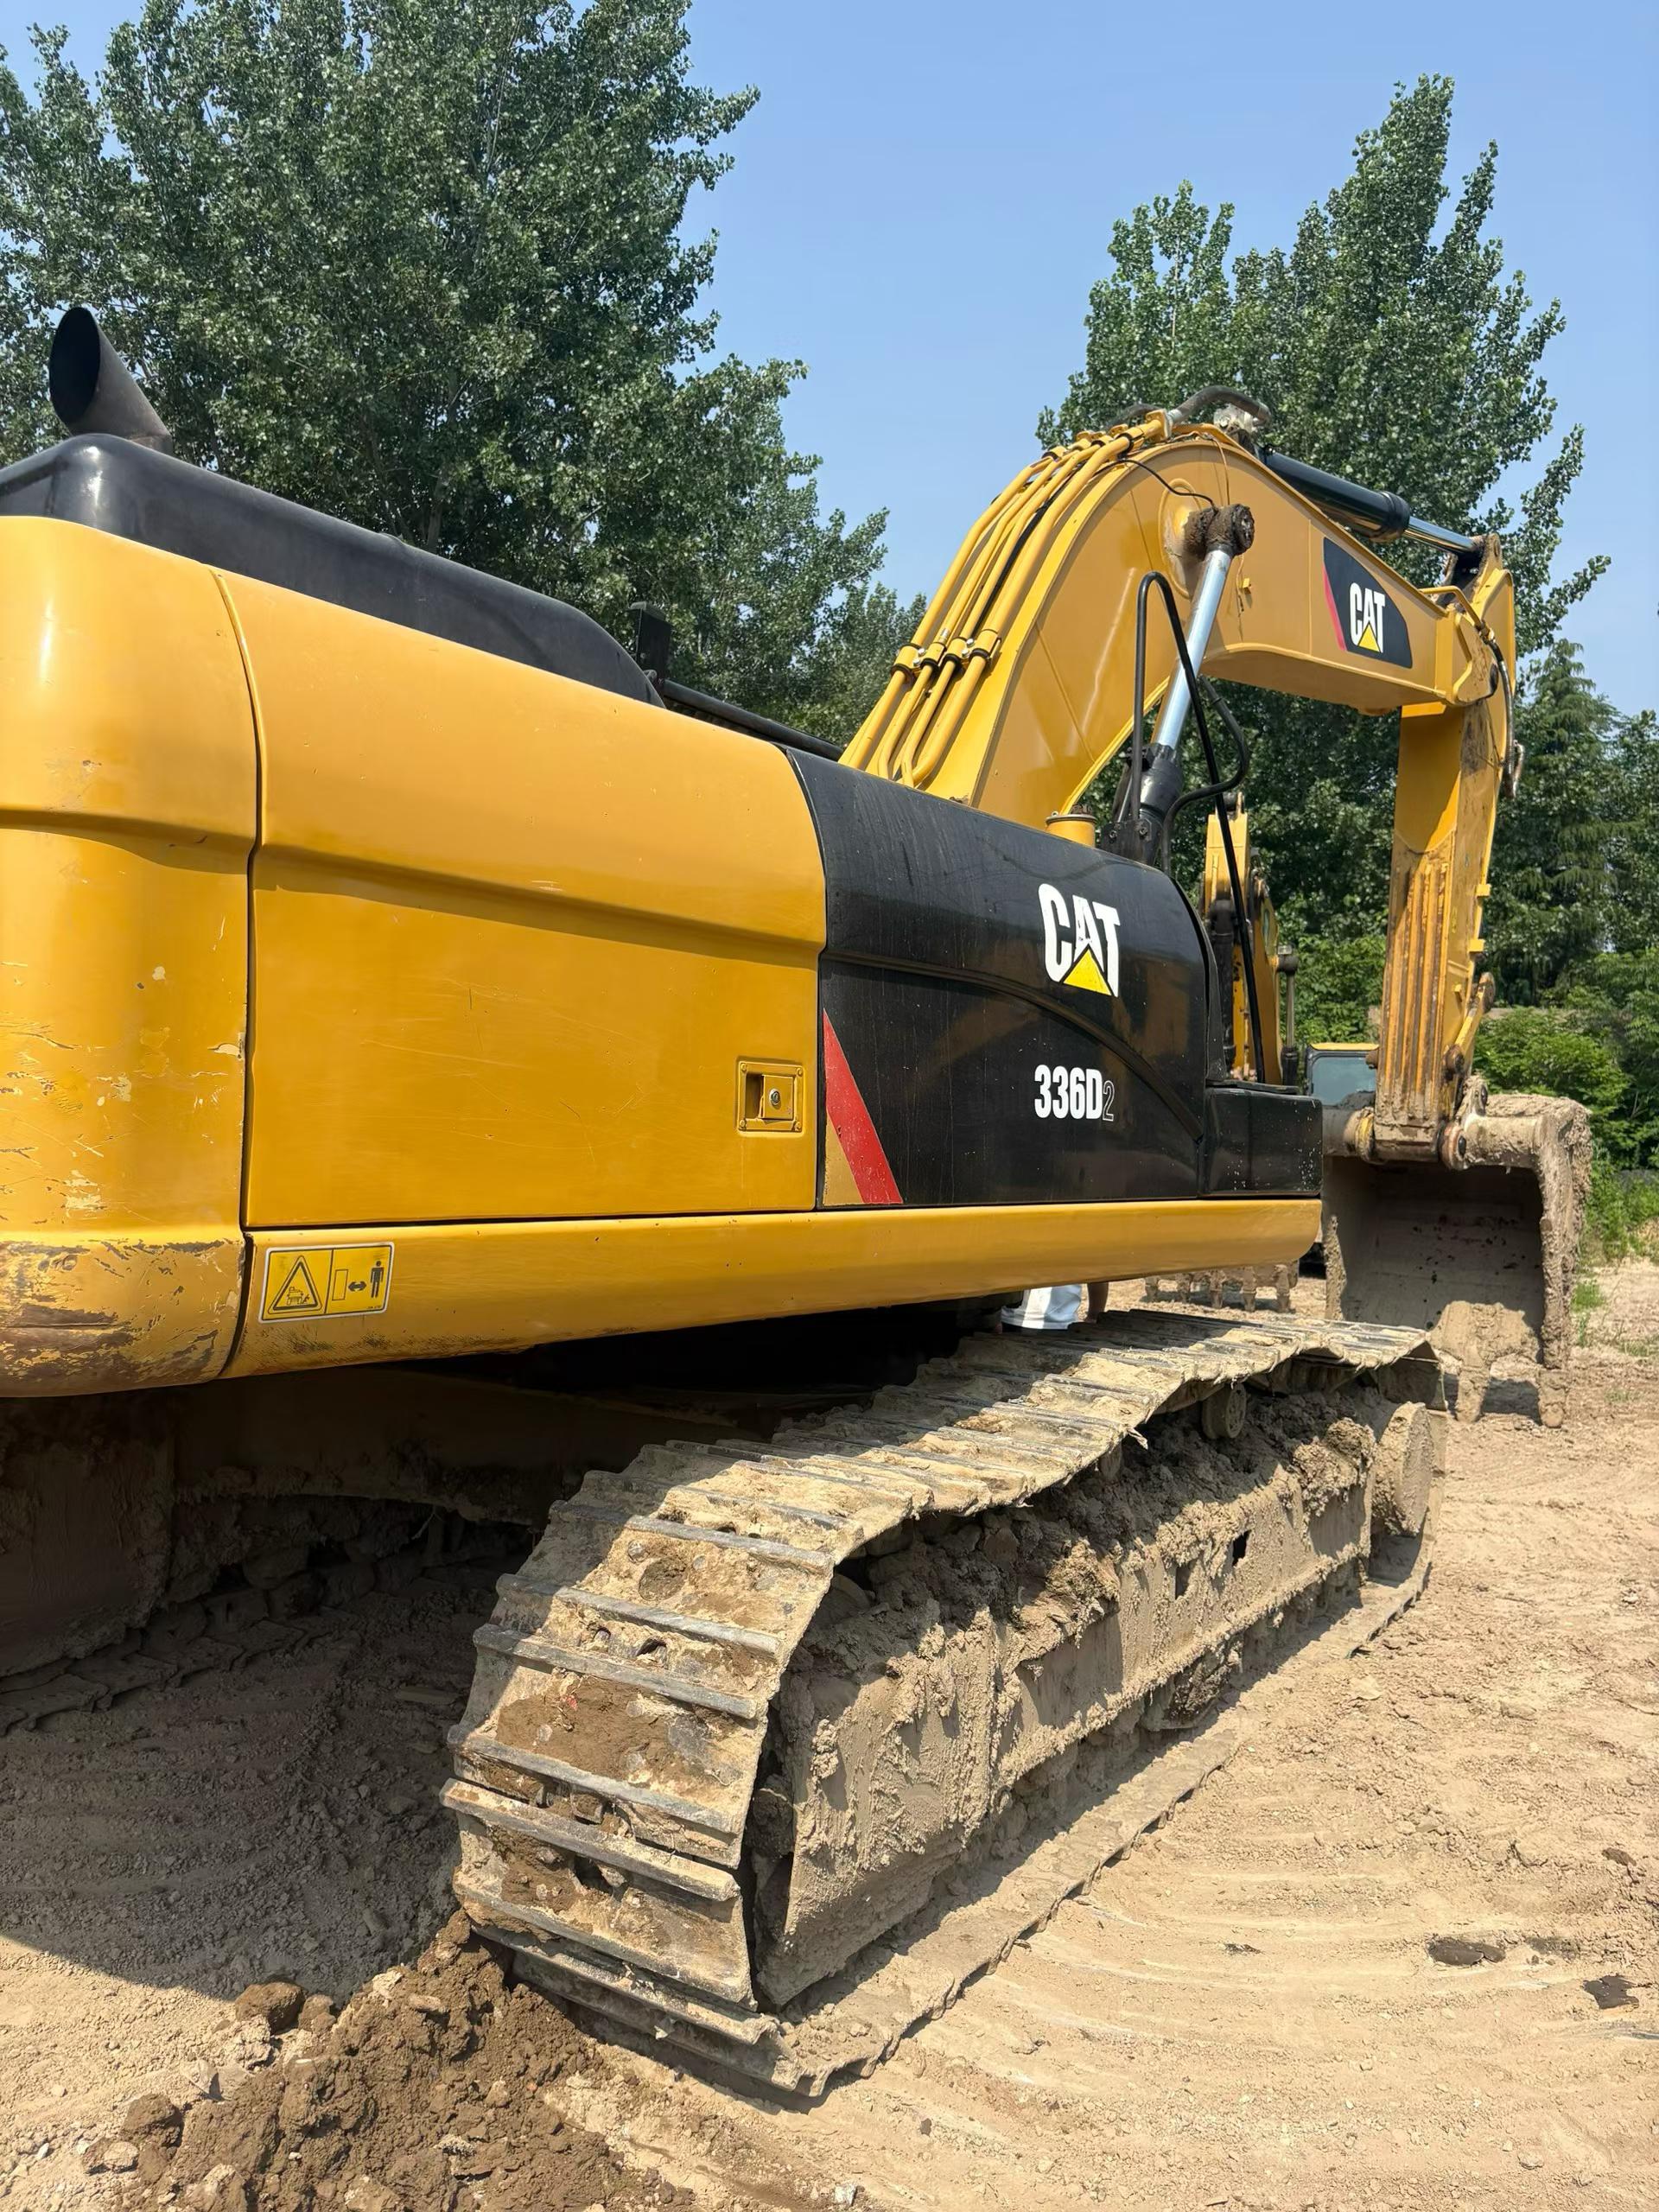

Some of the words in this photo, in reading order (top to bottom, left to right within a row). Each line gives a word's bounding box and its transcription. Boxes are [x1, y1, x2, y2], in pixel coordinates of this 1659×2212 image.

[1350, 582, 1385, 653] CAT
[1038, 883, 1121, 997] CAT
[1034, 1064, 1115, 1122] 336D2
